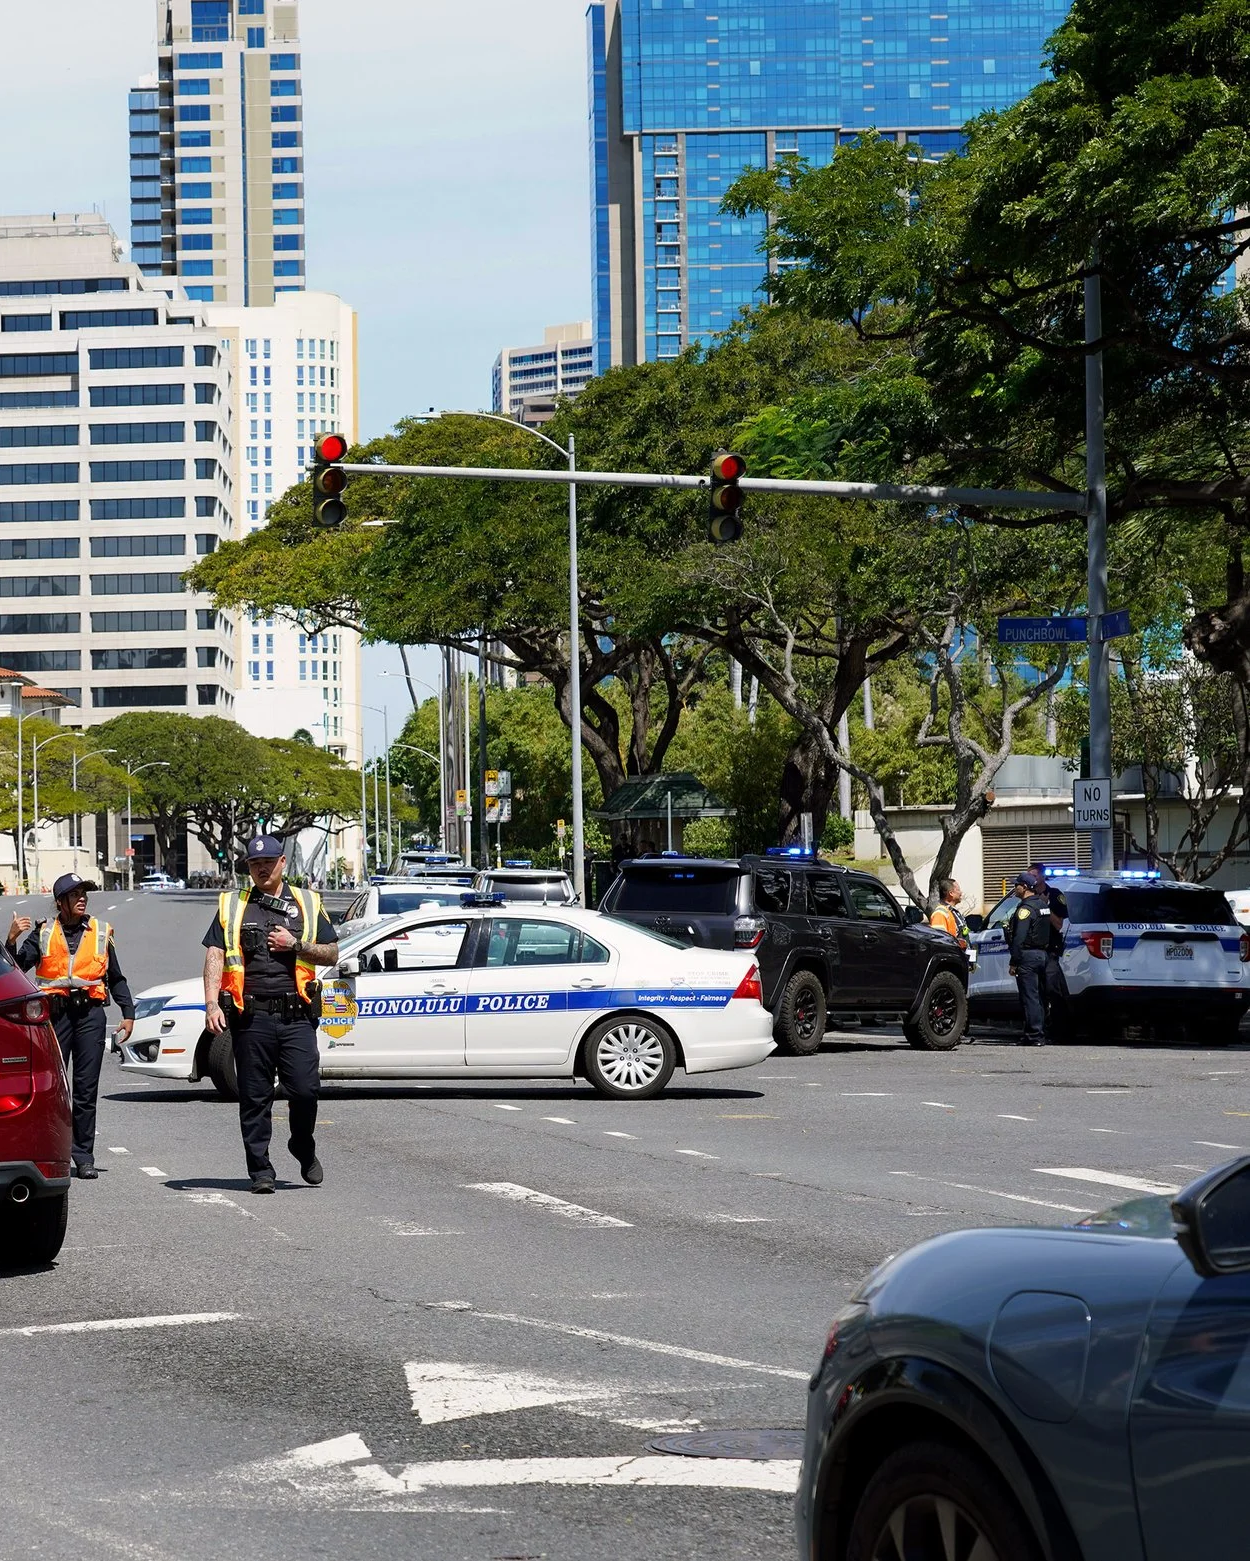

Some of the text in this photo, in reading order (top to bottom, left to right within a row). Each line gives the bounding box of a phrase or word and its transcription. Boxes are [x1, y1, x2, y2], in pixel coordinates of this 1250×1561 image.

[1005, 627, 1070, 641] PUNCHBOWL
[1084, 787, 1101, 802] NO
[1077, 809, 1109, 822] TURNS
[1193, 923, 1226, 932] POLICE
[360, 994, 550, 1015] HONOLULU POLICE
[638, 994, 727, 1003] Integrity Respect Fairness
[319, 1017, 353, 1025] POLICE
